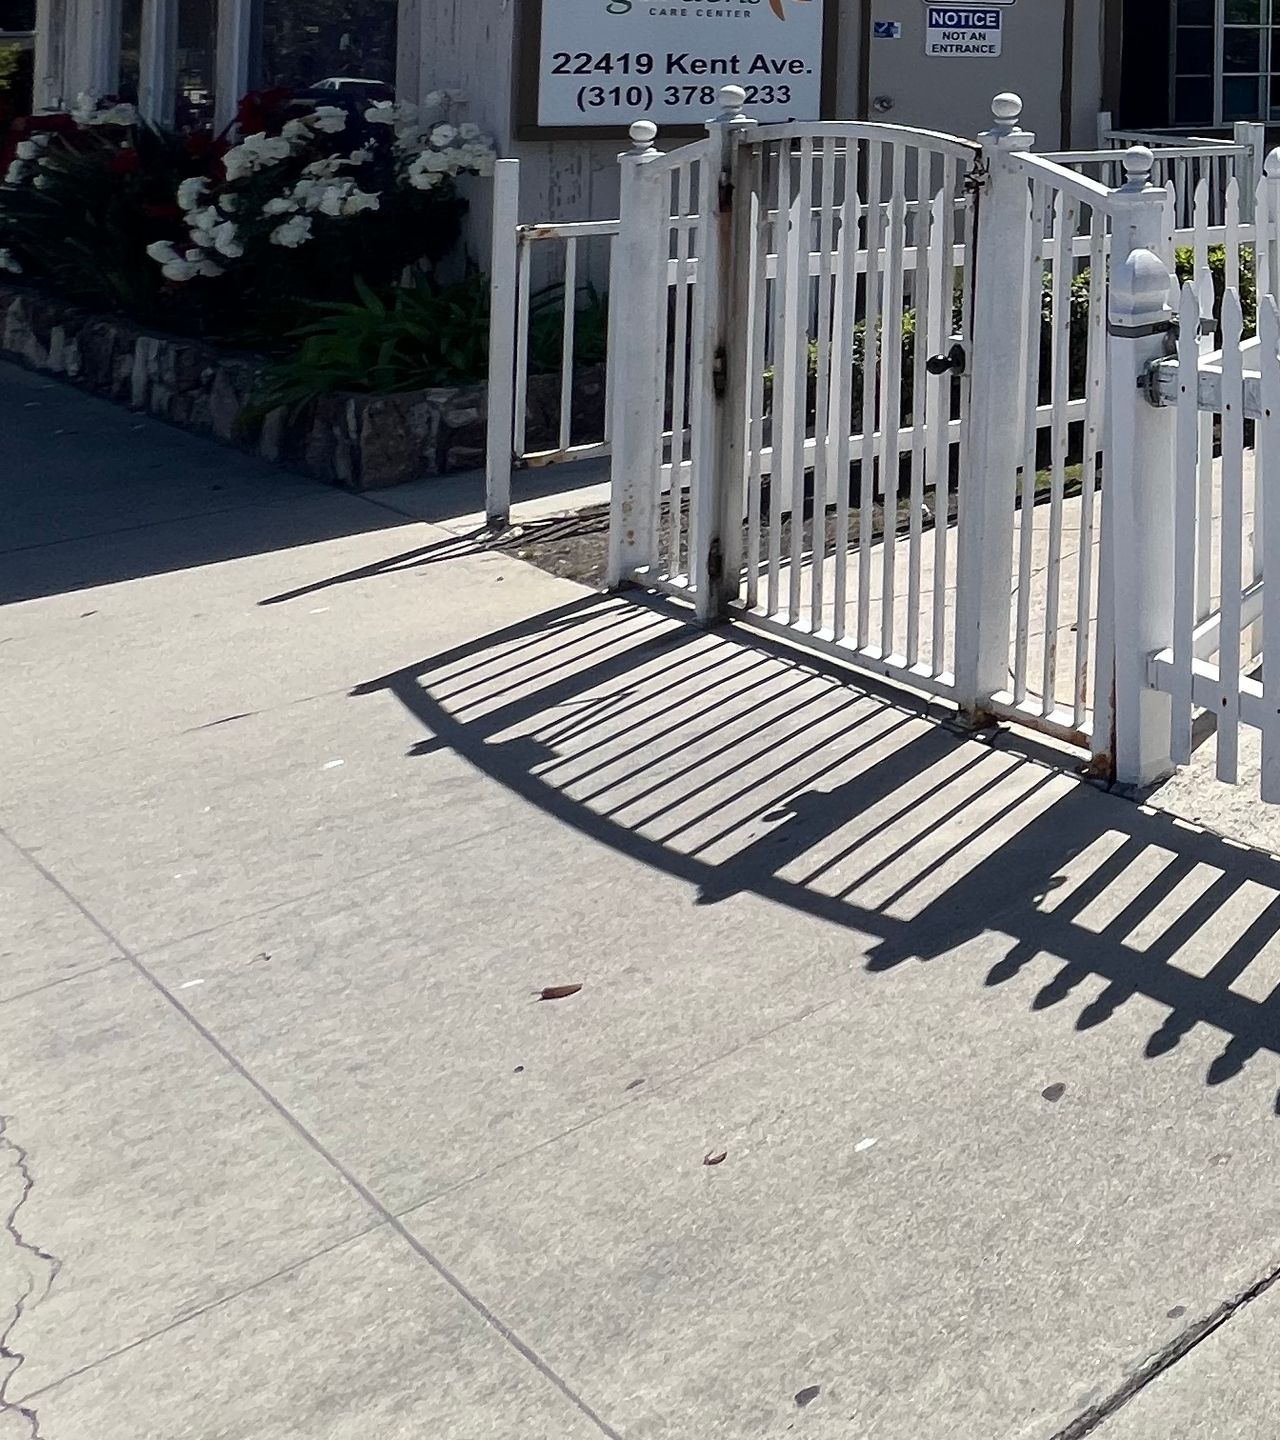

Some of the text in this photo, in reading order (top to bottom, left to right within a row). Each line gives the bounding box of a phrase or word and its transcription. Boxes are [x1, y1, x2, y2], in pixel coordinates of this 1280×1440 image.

[649, 7, 751, 18] CARE CENTER
[931, 11, 997, 27] NOTICE
[942, 31, 986, 41] NOT AN
[931, 44, 996, 54] ENTRANCE
[551, 52, 812, 75] 22419 Kent Ave.
[576, 85, 653, 112] (310)
